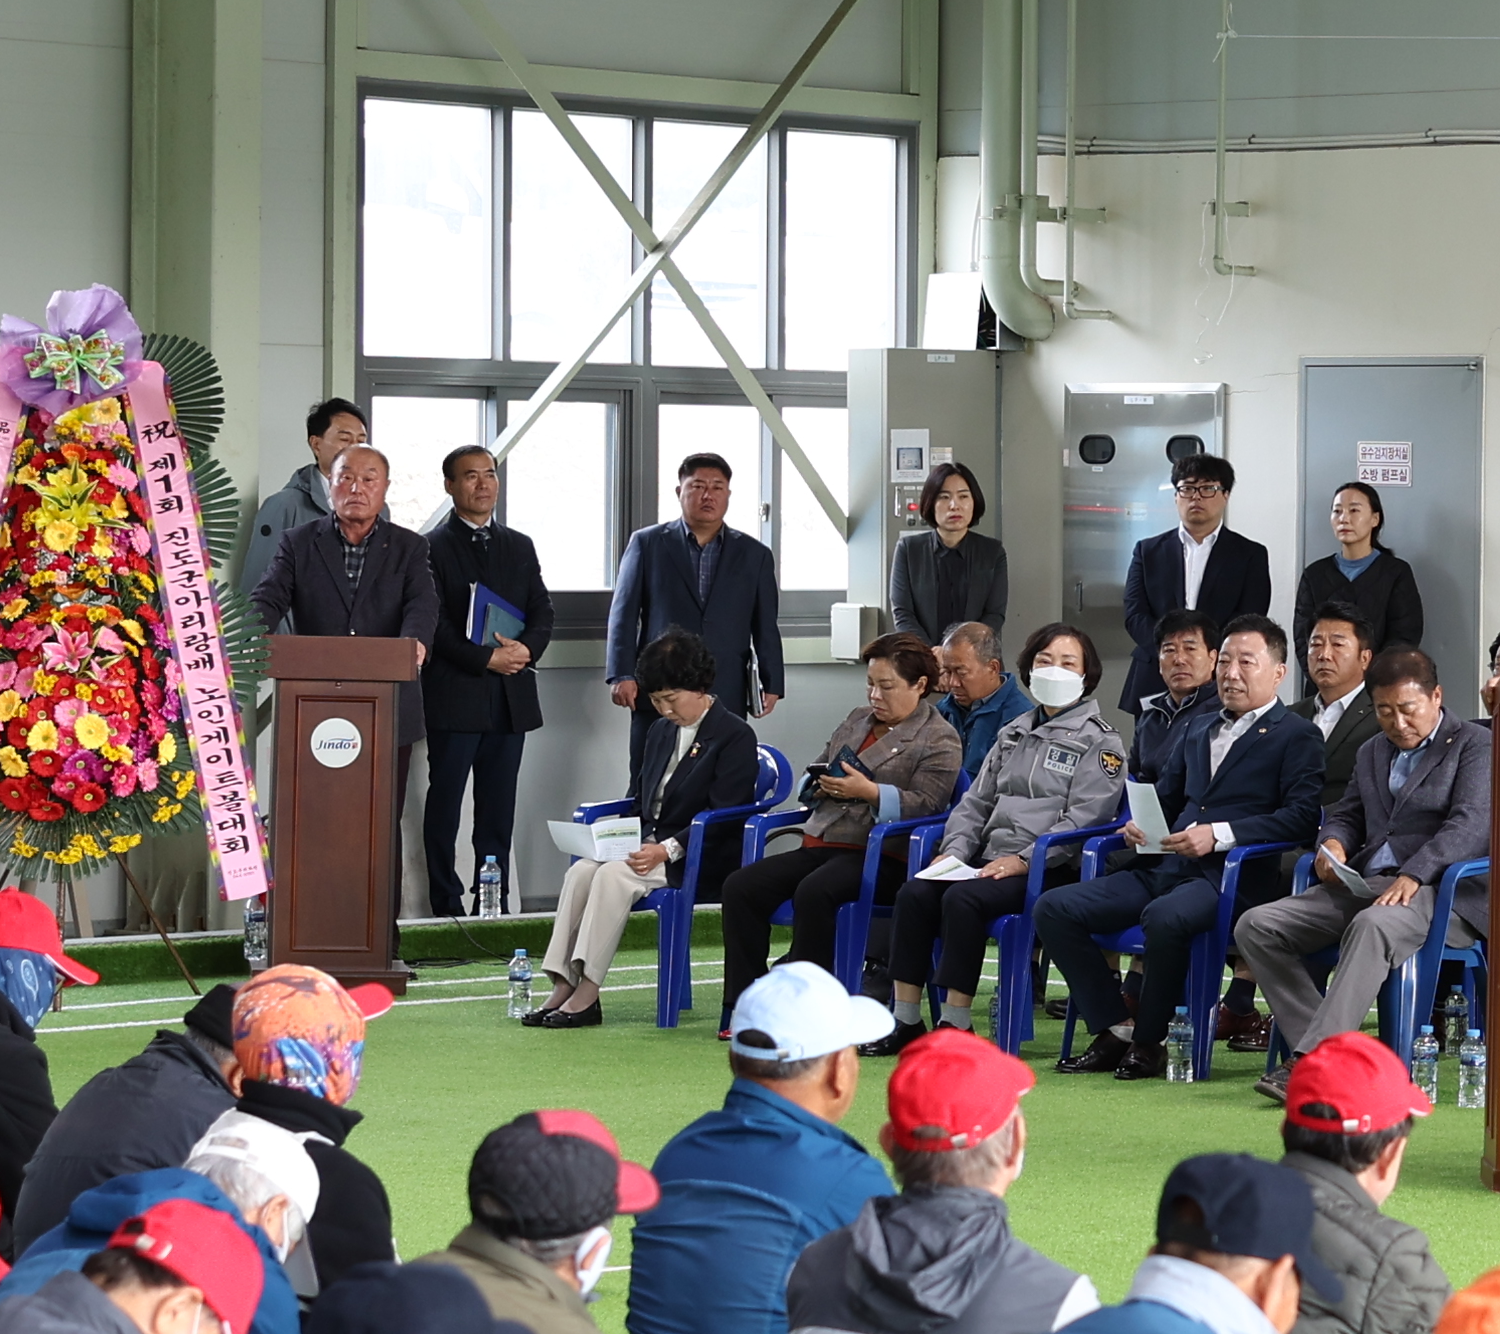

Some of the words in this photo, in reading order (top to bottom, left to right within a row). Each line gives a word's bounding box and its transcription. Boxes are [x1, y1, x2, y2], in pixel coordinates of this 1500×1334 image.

[141, 420, 178, 443] 祝
[147, 451, 184, 516] 제1회
[1360, 468, 1378, 482] 소방
[1381, 468, 1408, 482] 펌프실
[161, 526, 217, 672] 진도군아리랑배
[315, 737, 351, 751] Jindo
[1047, 762, 1073, 773] POLICE
[1050, 749, 1076, 766] 경찰
[193, 687, 250, 855] 노인게이트볼대회
